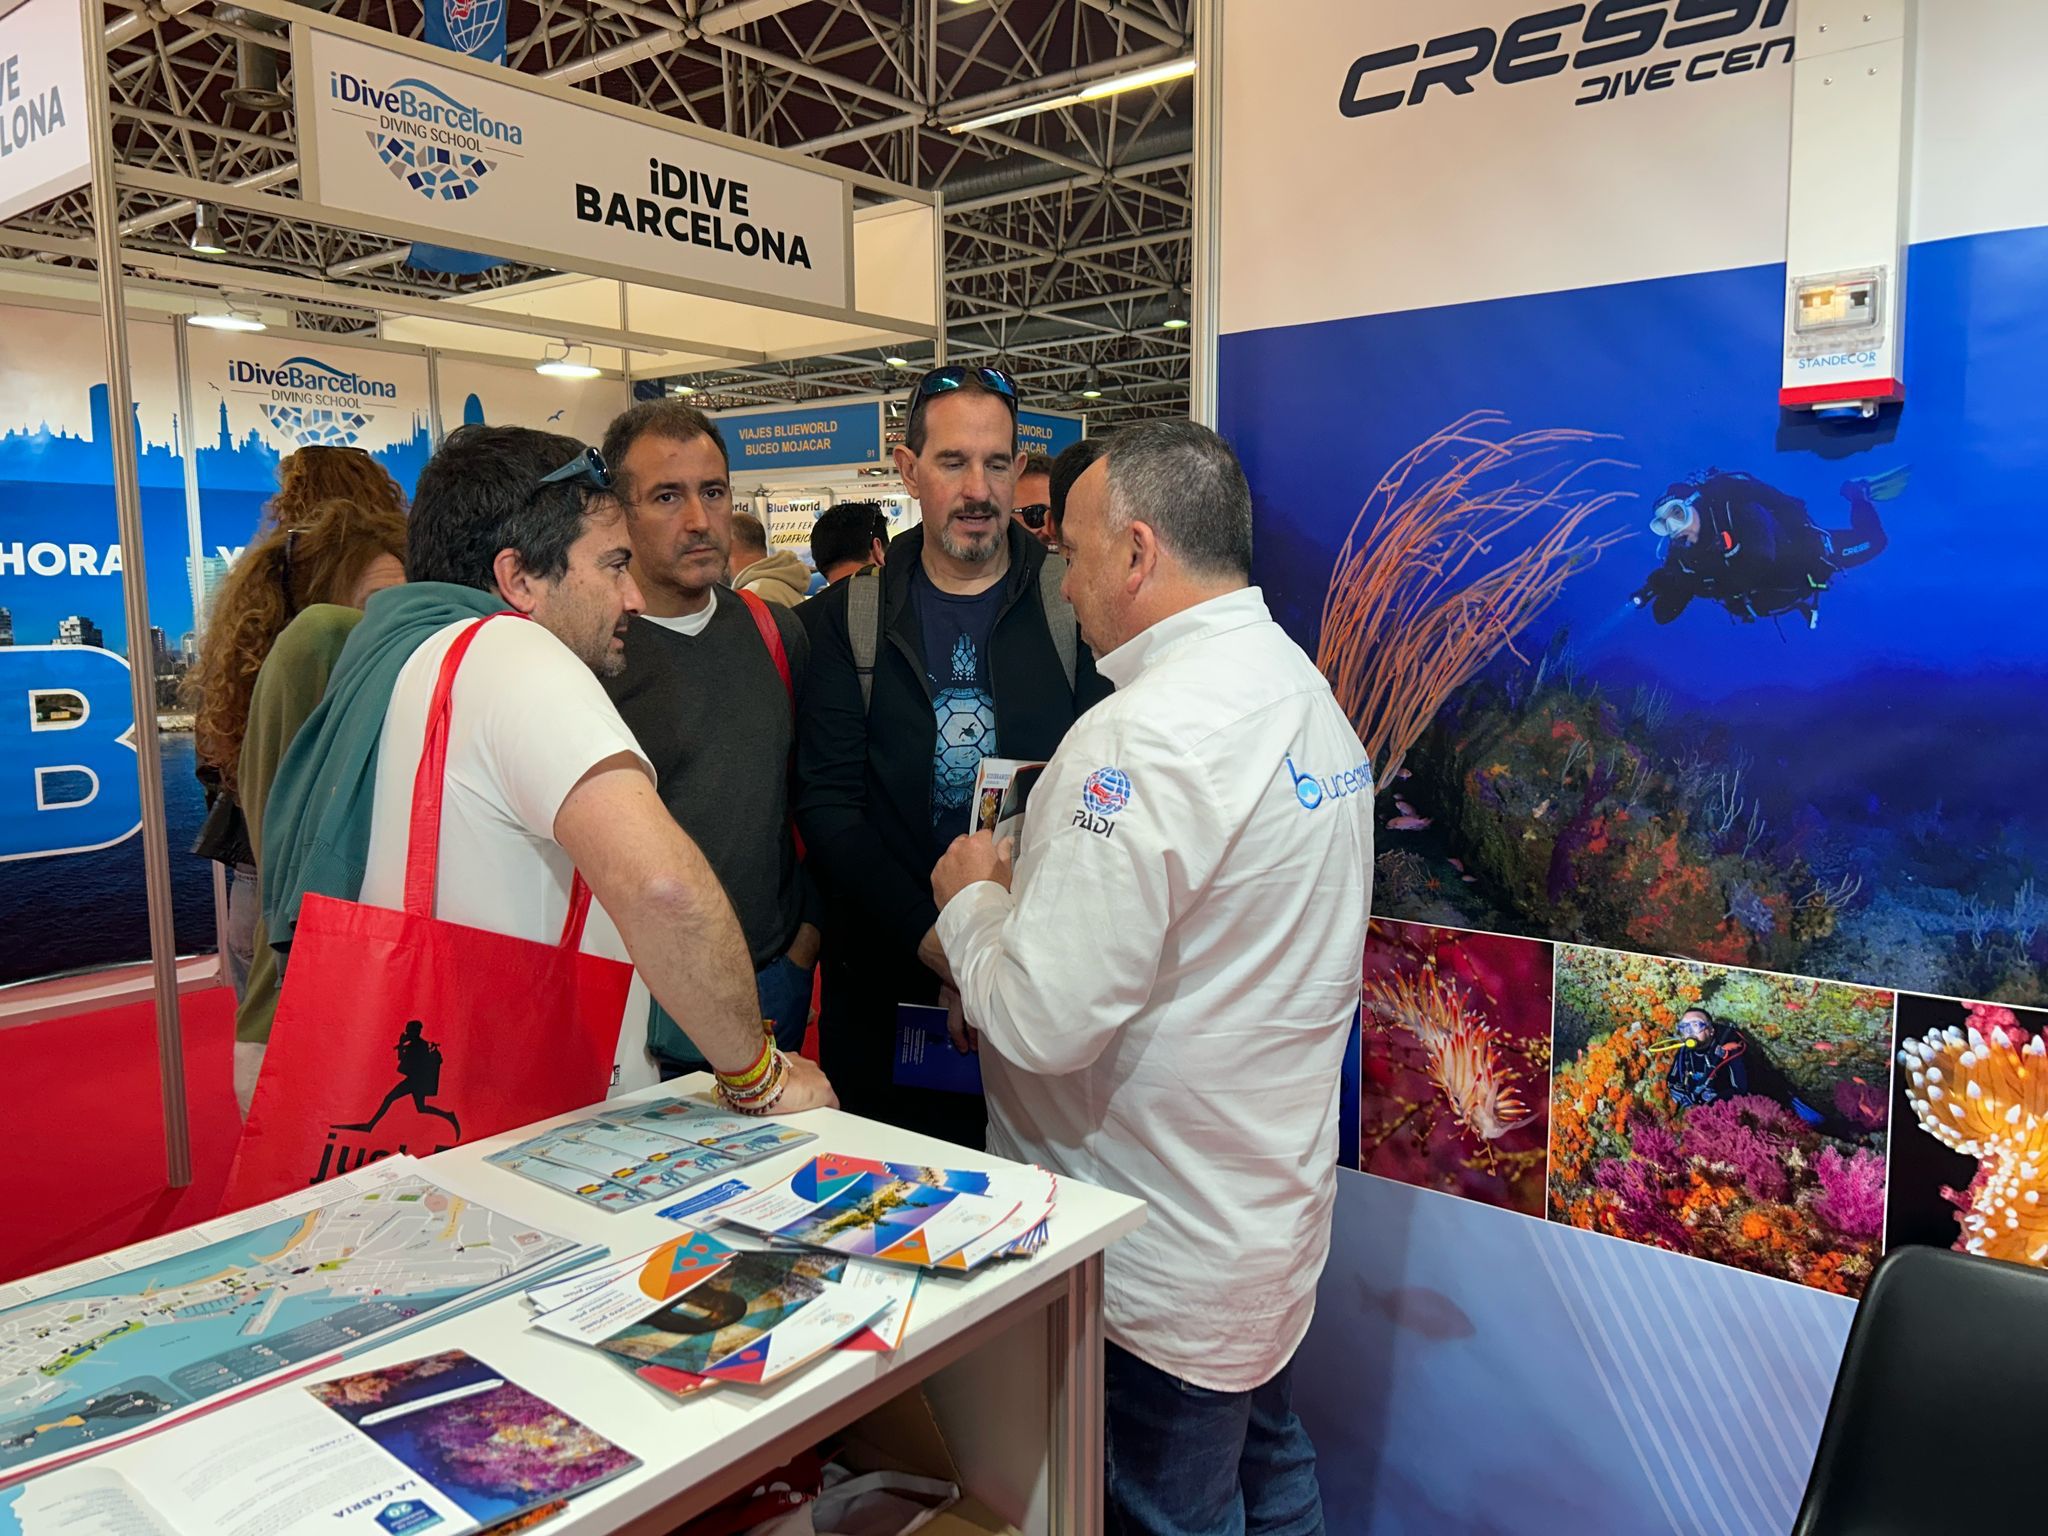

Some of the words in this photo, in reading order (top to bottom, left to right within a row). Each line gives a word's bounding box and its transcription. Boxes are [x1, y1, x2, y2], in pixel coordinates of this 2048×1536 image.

[1575, 59, 1682, 106] DIVE
[330, 71, 523, 145] iDiveBarcelona
[380, 114, 427, 139] DIVING
[430, 128, 483, 153] SCHOOL
[650, 157, 749, 217] iDIVE
[575, 183, 812, 270] BARCELONA
[1798, 351, 1877, 369] STANDECOR
[228, 359, 397, 398] iDiveBarcelona
[271, 389, 312, 405] DIVING
[315, 395, 361, 409] SCHOOL
[739, 426, 772, 440] VIAJES
[774, 420, 838, 438] BLUEWORLD
[745, 442, 779, 456] BUCEO
[781, 438, 831, 453] MOJACAR
[866, 450, 875, 458] 91
[1018, 441, 1048, 455] JACAR
[767, 501, 820, 513] BlueWorld
[1072, 809, 1116, 838] PADI
[332, 1489, 394, 1518] CABRIA
